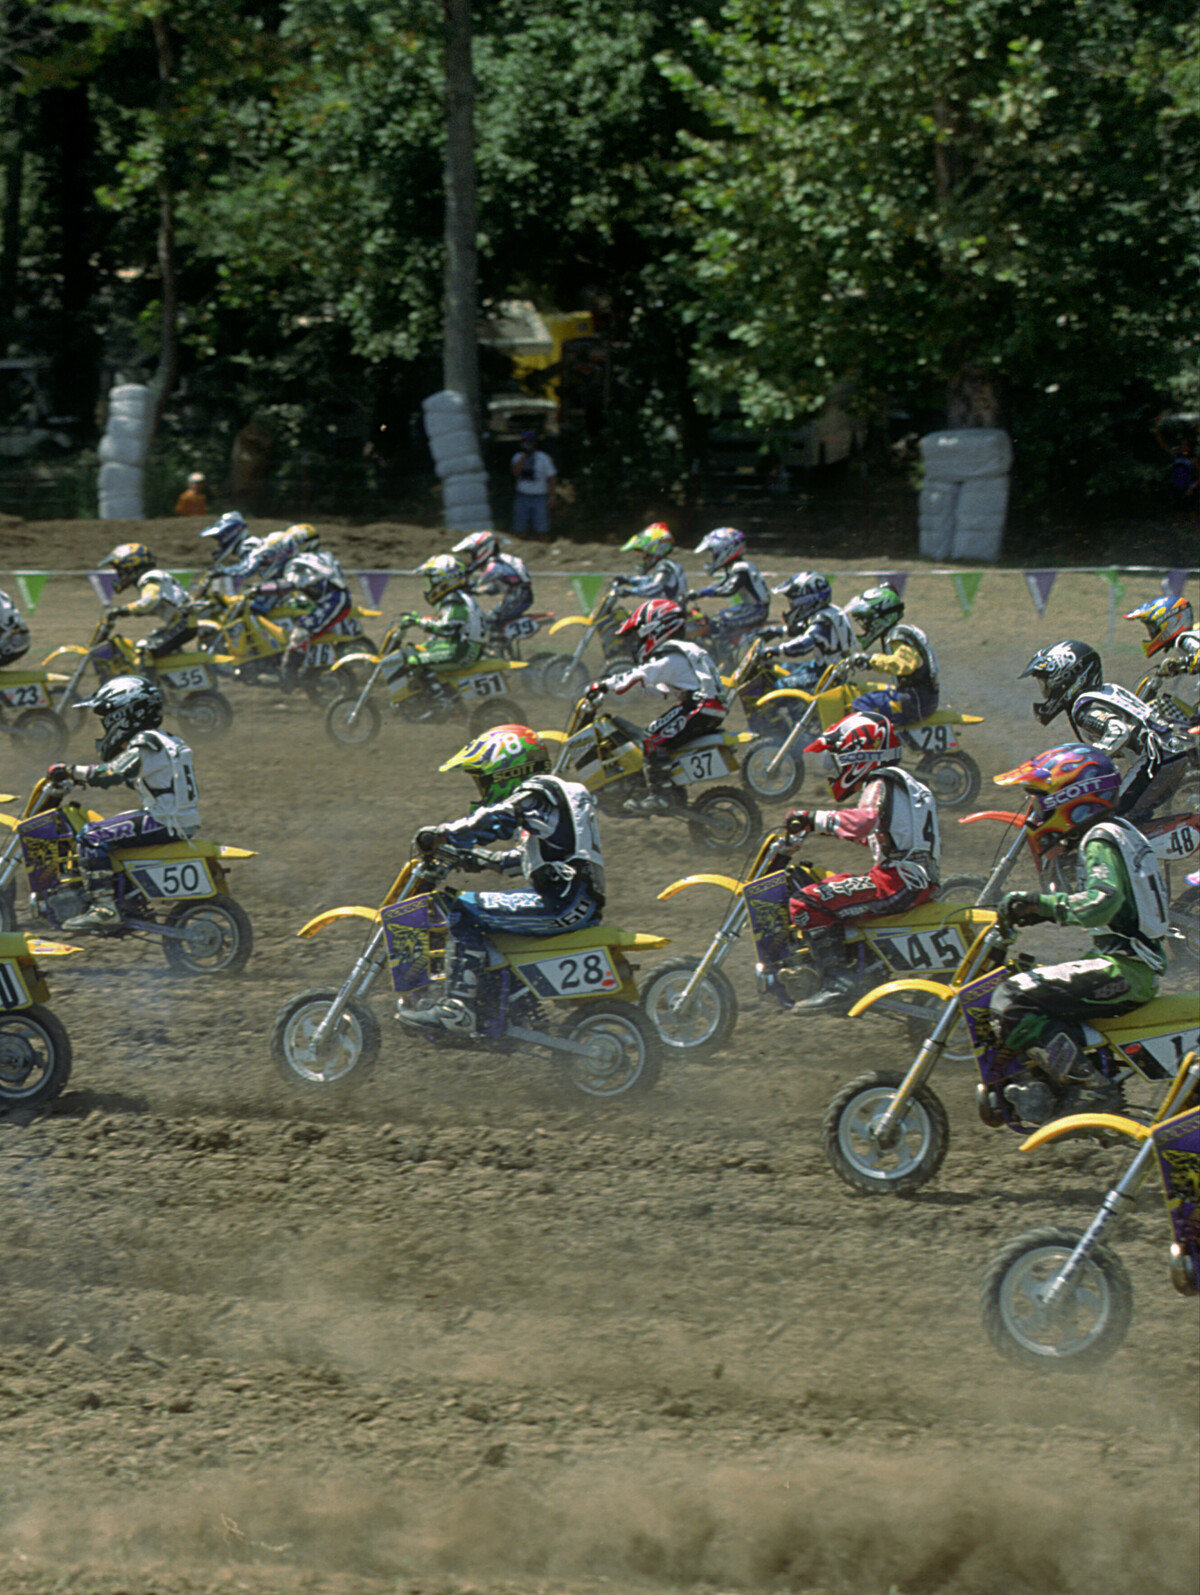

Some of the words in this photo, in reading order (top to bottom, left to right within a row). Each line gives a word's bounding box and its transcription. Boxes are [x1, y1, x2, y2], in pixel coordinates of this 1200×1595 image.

[508, 619, 535, 639] 39
[177, 669, 204, 690] 35
[474, 675, 504, 696] 51
[14, 686, 39, 705] 23
[488, 732, 523, 764] 28
[920, 725, 947, 751] 29
[690, 752, 713, 779] 37
[840, 751, 884, 765] SCOTT
[492, 761, 536, 783] SCOTT
[1042, 778, 1102, 809] SCOTT
[1170, 827, 1194, 855] 48
[163, 864, 199, 894] 50
[813, 876, 877, 902] FOX
[479, 891, 545, 912] FOX
[905, 928, 960, 971] 45
[558, 954, 604, 990] 28
